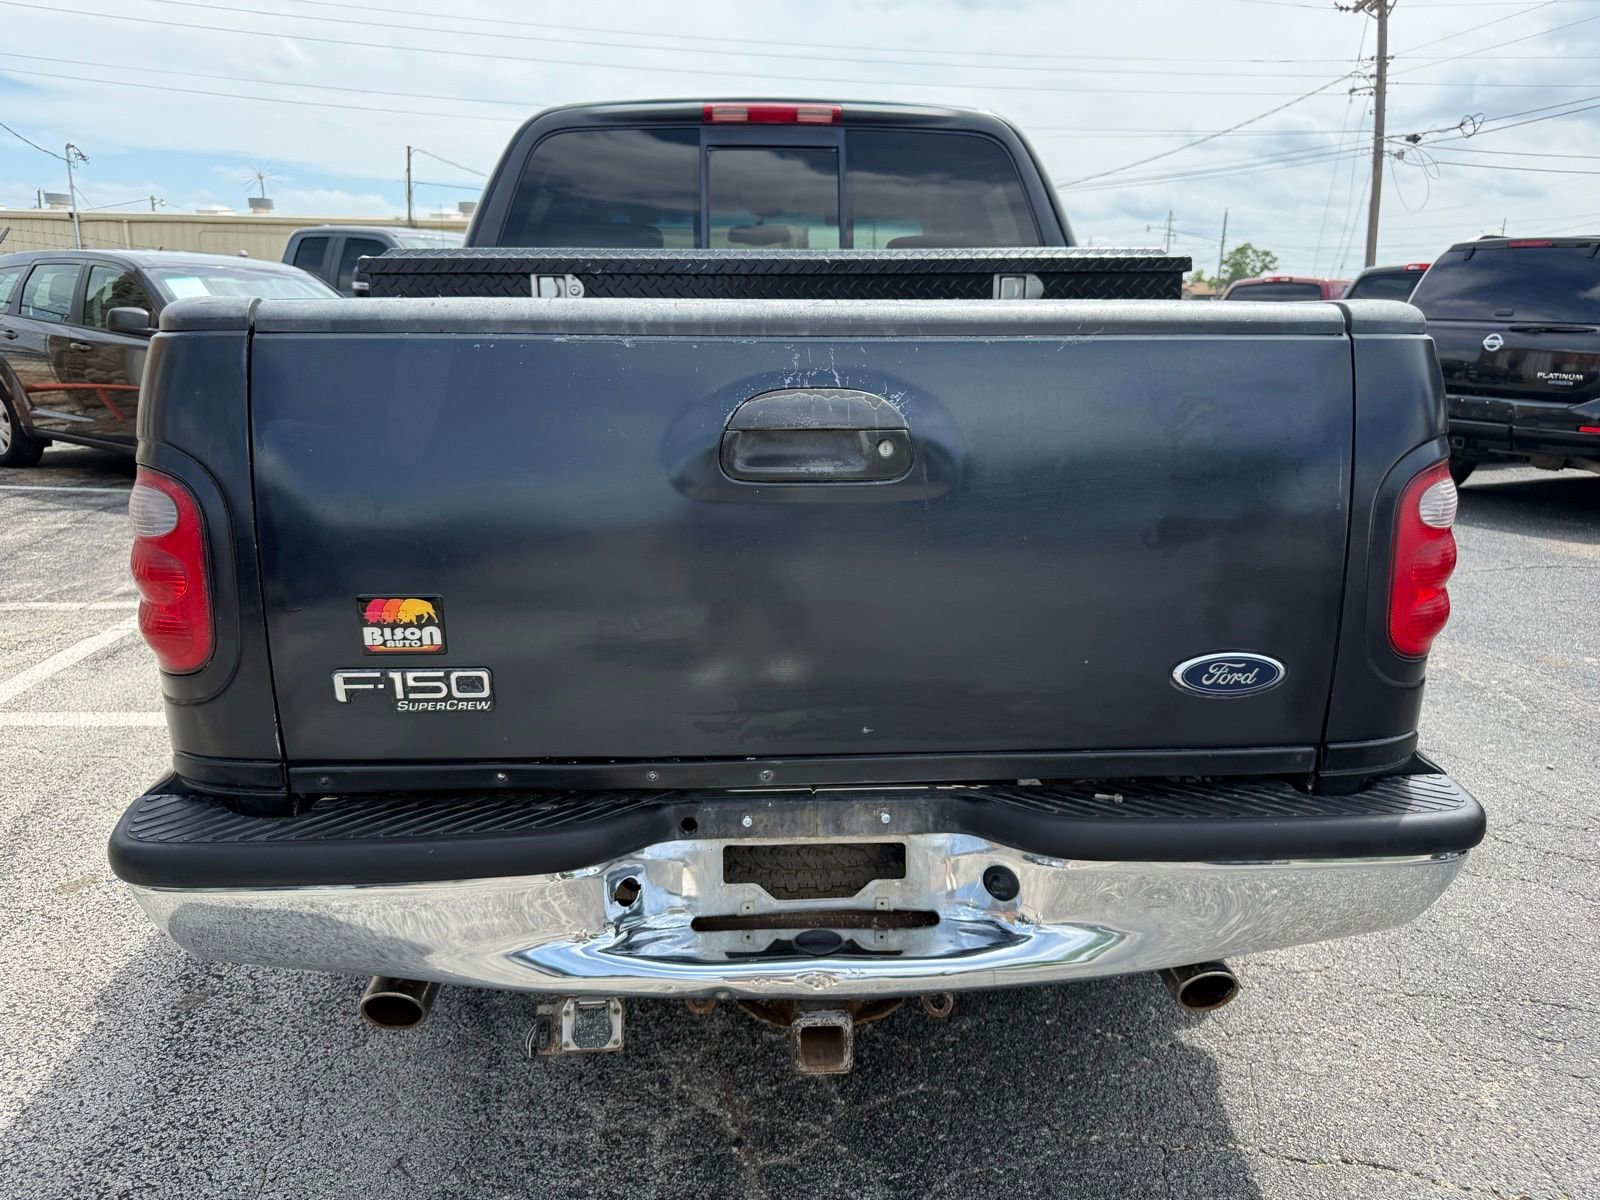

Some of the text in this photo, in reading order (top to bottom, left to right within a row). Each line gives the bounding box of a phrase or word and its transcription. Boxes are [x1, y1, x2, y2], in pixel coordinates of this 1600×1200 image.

[1537, 371, 1584, 381] PLATINUM
[362, 625, 442, 646] BISON
[386, 639, 421, 648] AUTO
[1201, 662, 1259, 685] Ford
[333, 671, 491, 702] F-150
